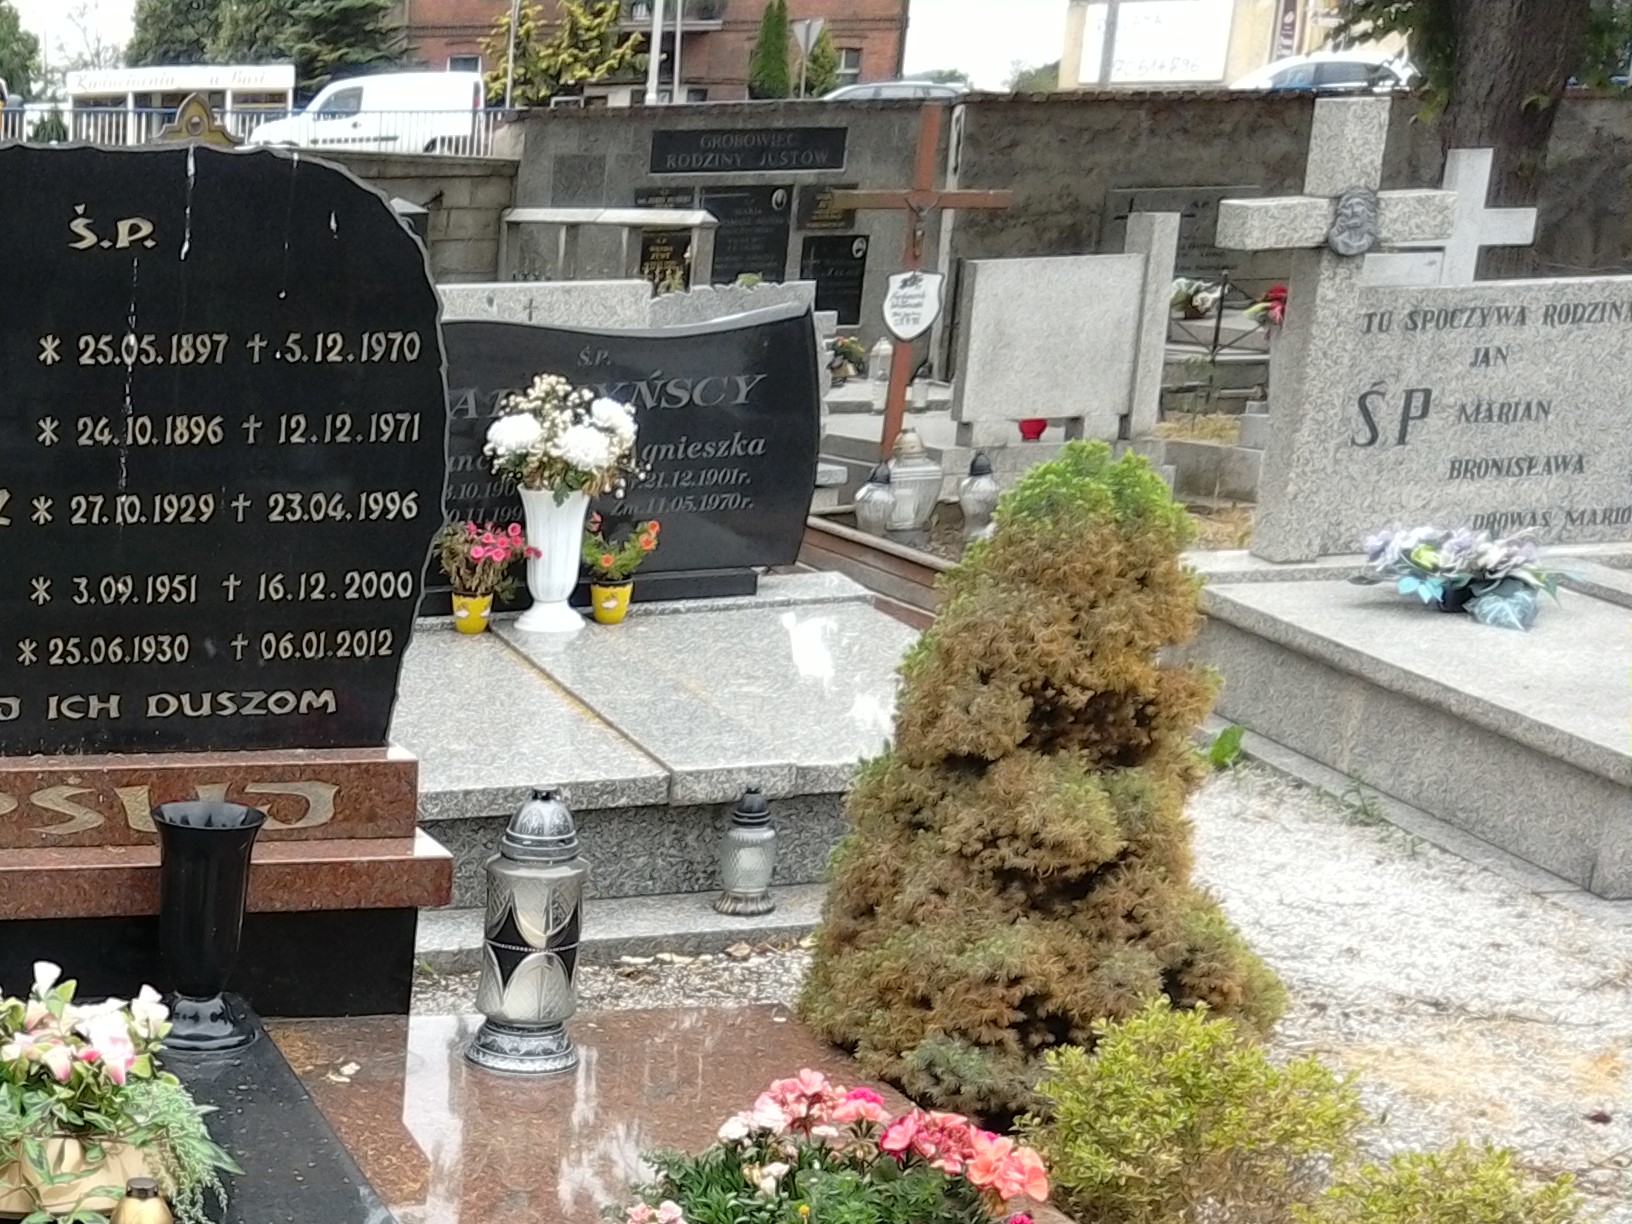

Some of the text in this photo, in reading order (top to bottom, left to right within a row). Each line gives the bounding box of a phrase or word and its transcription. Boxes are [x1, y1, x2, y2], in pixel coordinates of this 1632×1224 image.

[667, 152, 744, 168] RODZINY
[1362, 311, 1393, 334] TU
[1404, 305, 1528, 332] SPOCZYWA
[77, 332, 229, 366] 25.05.1897
[284, 330, 421, 364] 5.12.1970
[1469, 346, 1511, 368] JAN
[1457, 400, 1553, 425] MARIAN
[76, 413, 224, 447] 24.10.1896
[278, 412, 421, 445] 12.12.1971
[633, 431, 767, 464] gnieszka
[1447, 454, 1586, 481] BRONISŁAWA
[70, 493, 215, 525] 27.10.1929
[267, 491, 419, 523] 23.04.1996
[72, 574, 199, 605] 3.09.1951
[257, 571, 413, 601] 16.12.2000
[48, 633, 190, 666] 25.06.1930
[260, 629, 394, 661] 06.01.2012
[46, 694, 120, 720] ICH
[145, 689, 337, 719] DUSZOM
